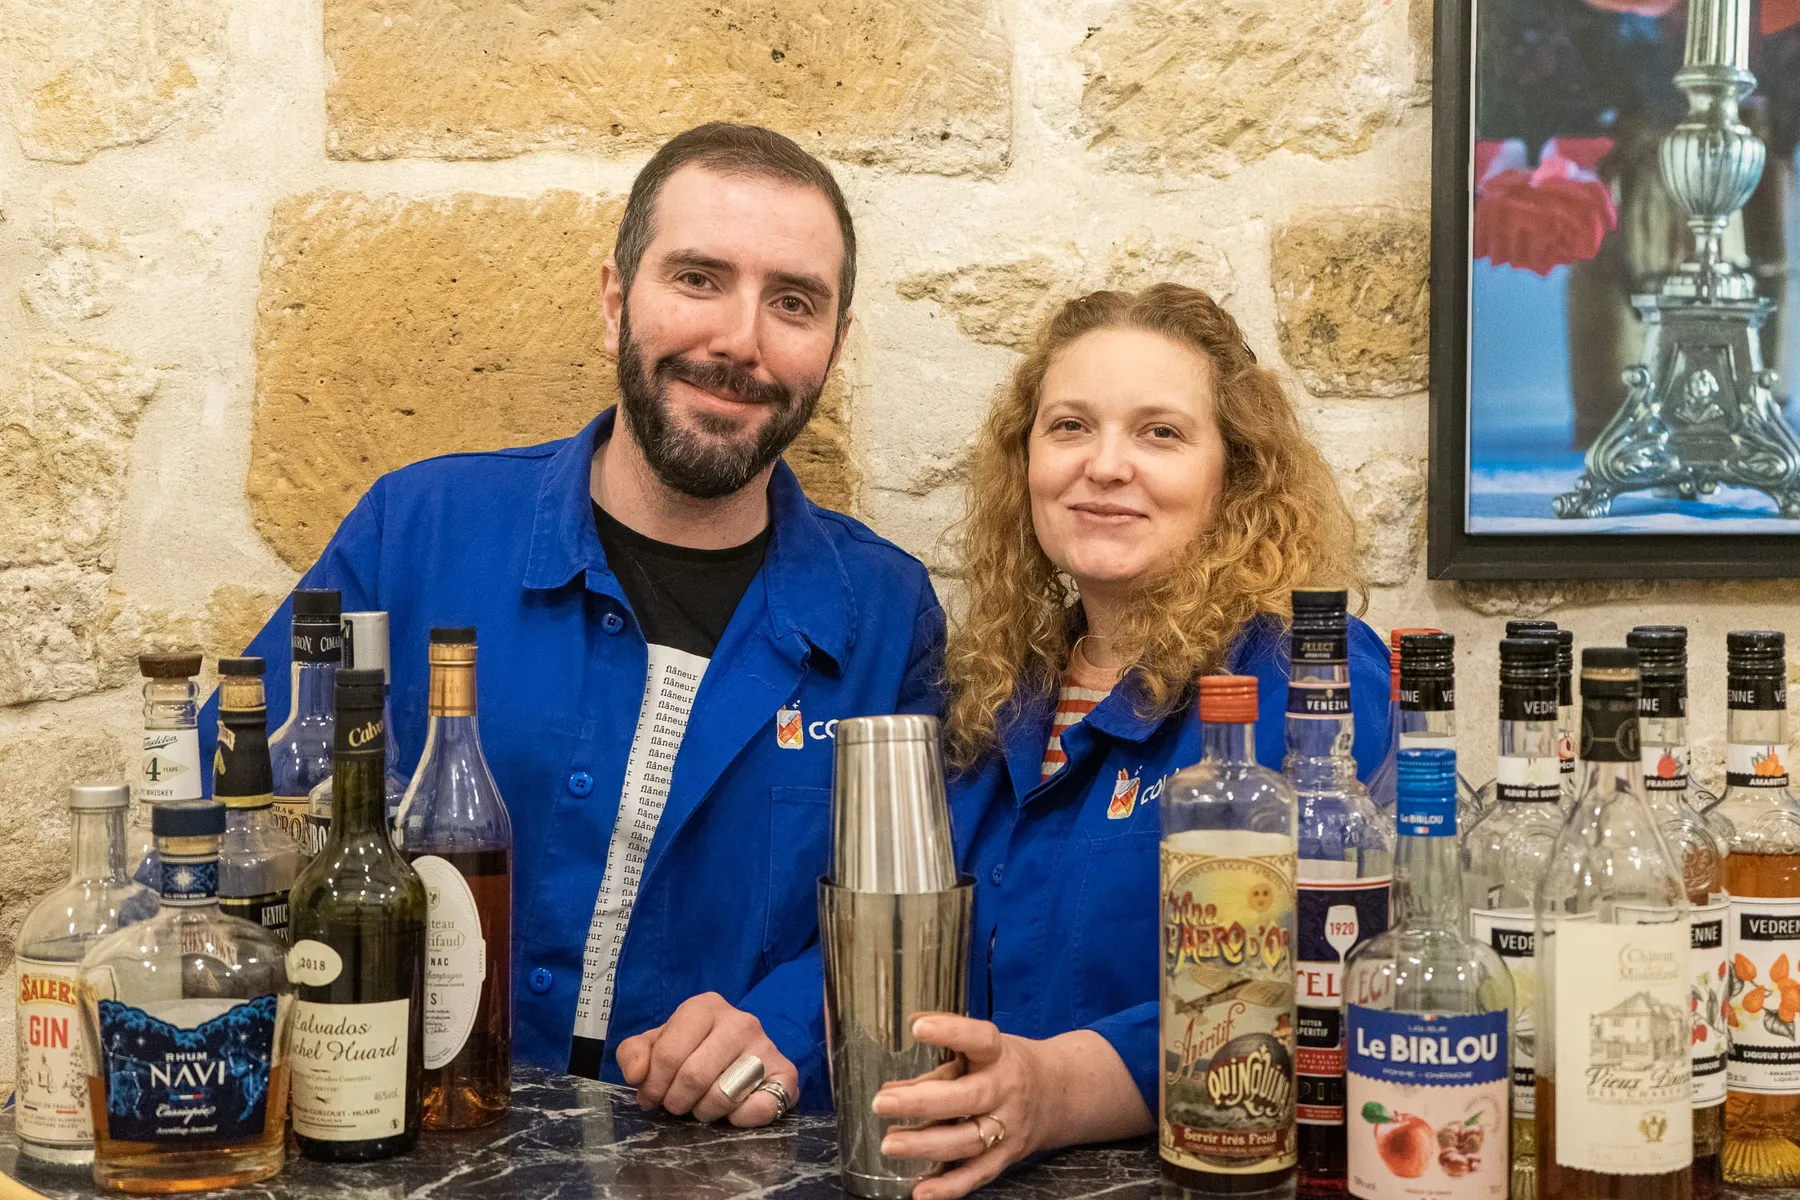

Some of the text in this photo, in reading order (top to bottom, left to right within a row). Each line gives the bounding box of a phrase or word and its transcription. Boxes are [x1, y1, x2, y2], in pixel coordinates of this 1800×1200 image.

[666, 665, 698, 680] flâneur
[663, 677, 695, 692] flâneur
[661, 689, 693, 704] flâneur
[658, 700, 690, 715] flâneur
[1306, 700, 1349, 710] VENEZIA
[656, 712, 688, 726] flâneur
[145, 757, 161, 781] 4
[625, 853, 646, 864] flân
[1328, 922, 1355, 936] 1920
[301, 957, 326, 970] 2018
[430, 957, 449, 966] NAC
[29, 1015, 68, 1049] GIN
[326, 1036, 399, 1061] Huard
[1357, 1027, 1498, 1066] Le BIRLOU
[165, 1052, 208, 1062] RHUM
[1743, 1050, 1778, 1060] LIQUEUR
[150, 1061, 226, 1088] NAVI
[1585, 1067, 1643, 1089] Vieux
[1184, 1127, 1219, 1144] Servir
